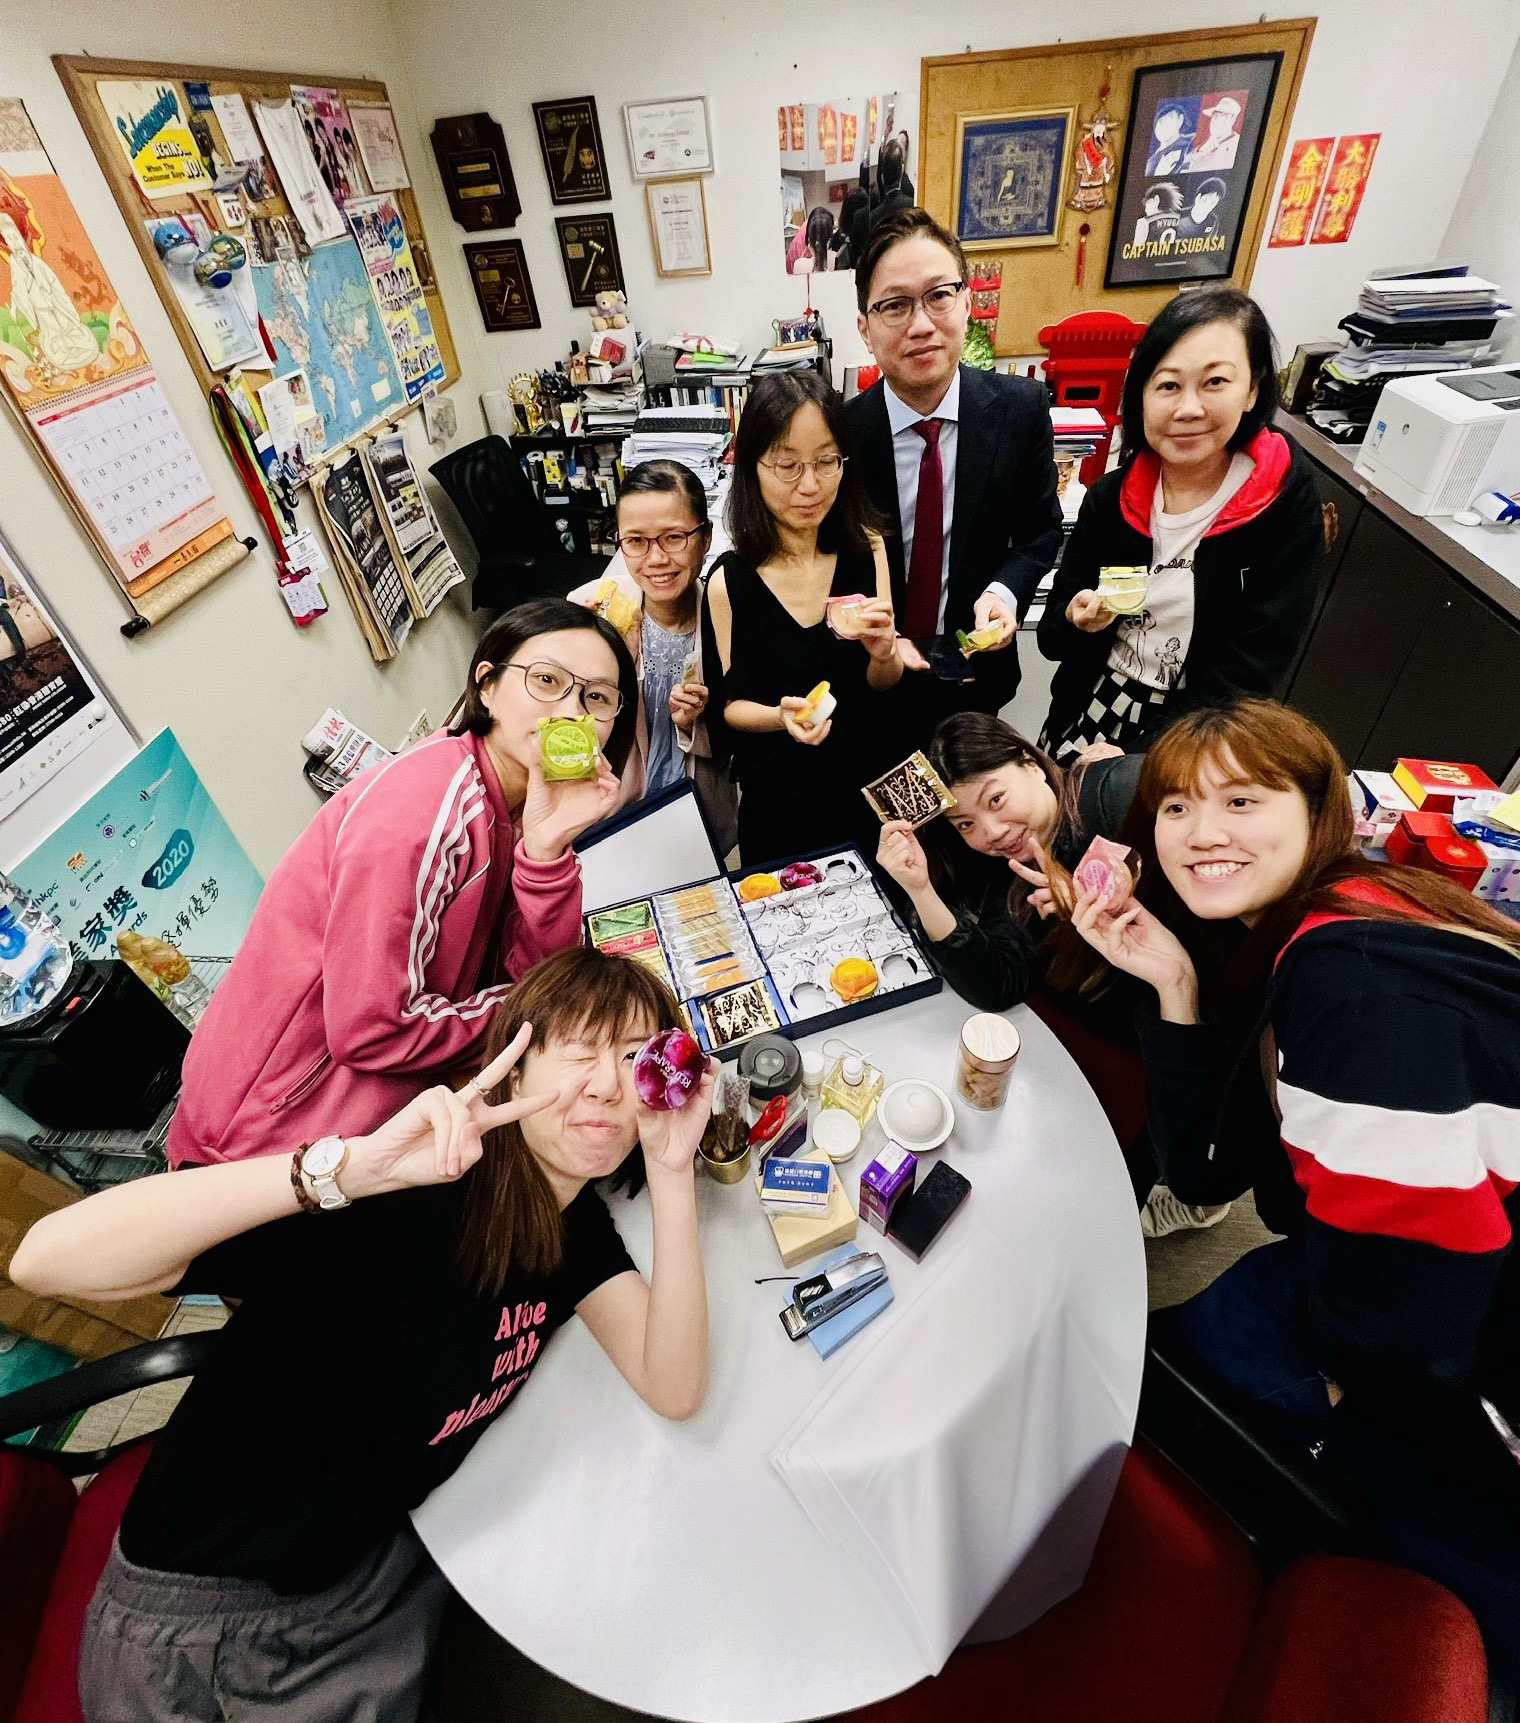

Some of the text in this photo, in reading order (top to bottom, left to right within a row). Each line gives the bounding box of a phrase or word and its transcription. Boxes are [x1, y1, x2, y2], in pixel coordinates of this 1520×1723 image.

[1122, 241, 1172, 260] CAPTAIN
[1174, 235, 1226, 256] TSUBASA
[152, 839, 191, 886] 2020
[36, 881, 59, 906] hkpc
[110, 911, 149, 958] Ards
[651, 1050, 692, 1089] RED GRAPE
[491, 1331, 540, 1382] with
